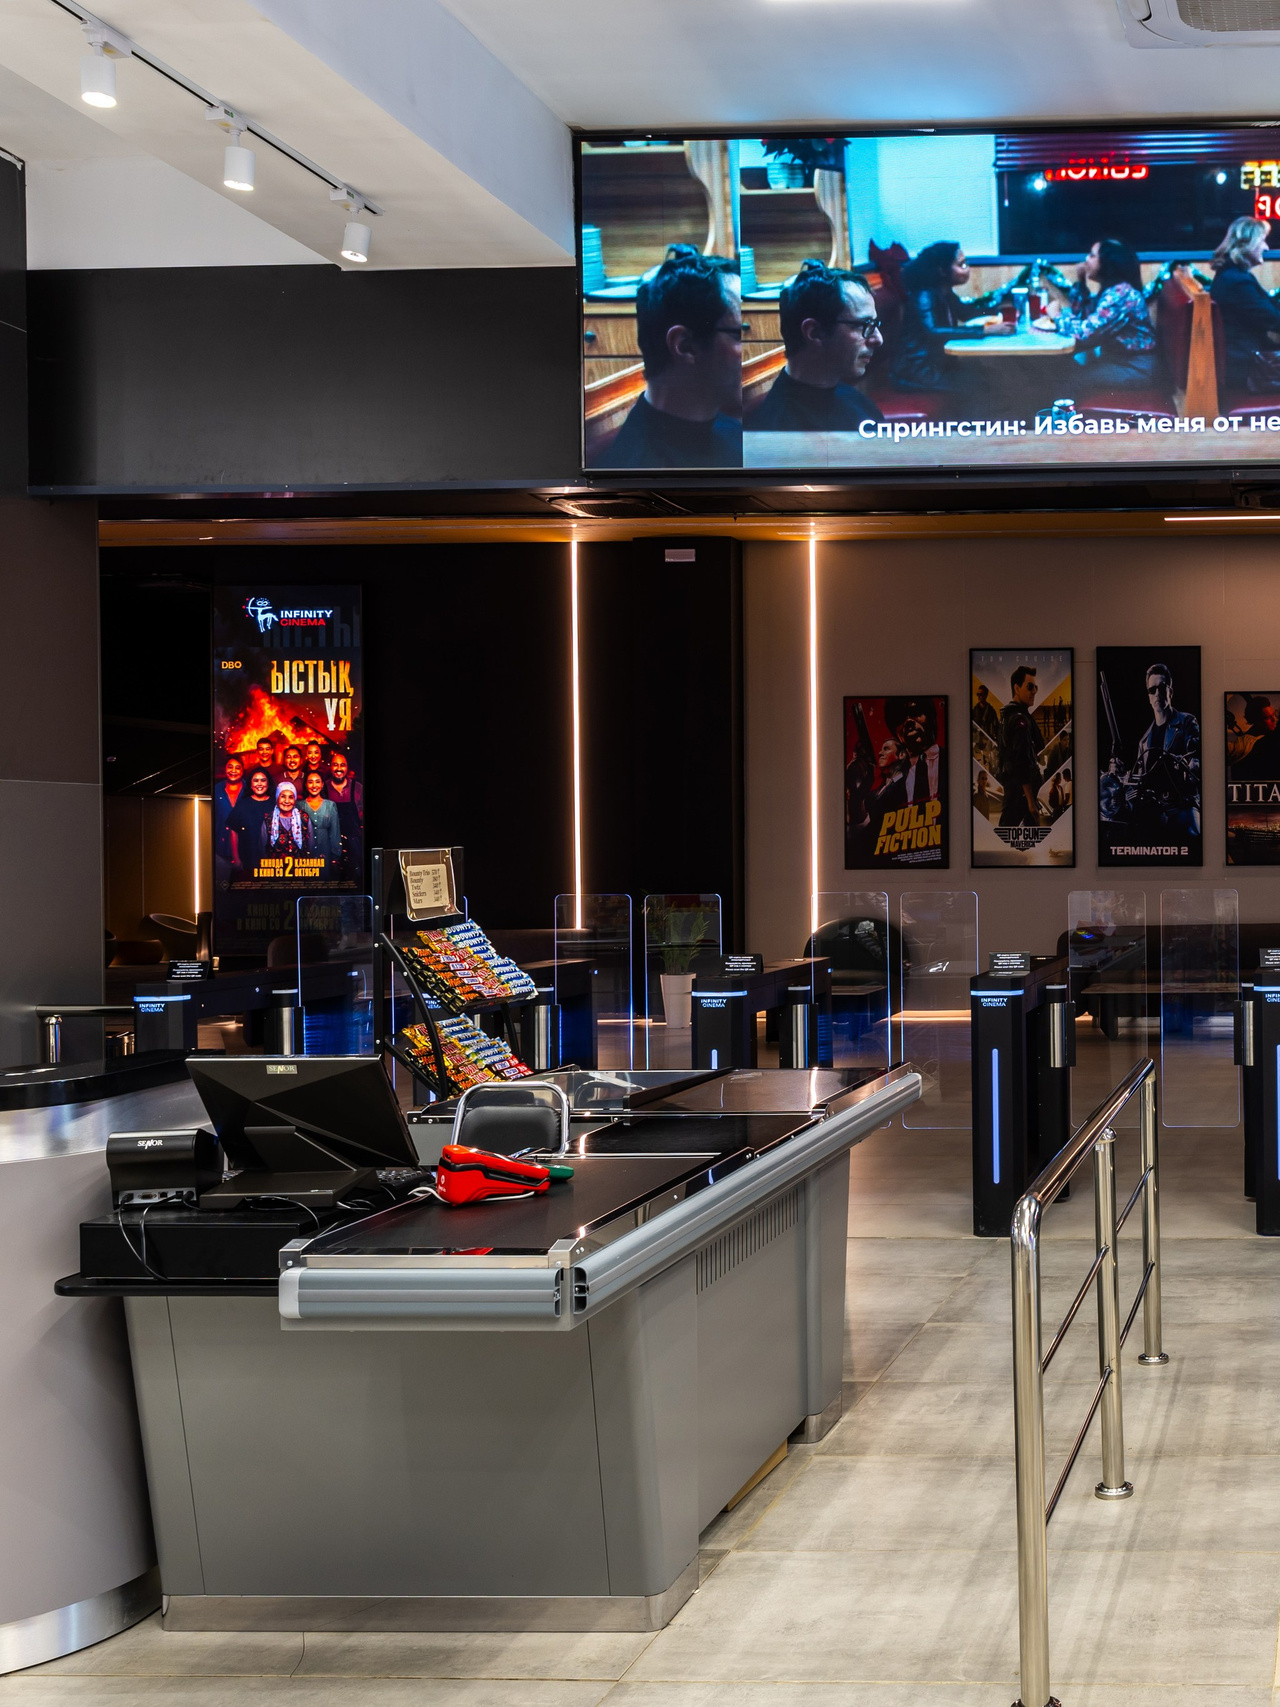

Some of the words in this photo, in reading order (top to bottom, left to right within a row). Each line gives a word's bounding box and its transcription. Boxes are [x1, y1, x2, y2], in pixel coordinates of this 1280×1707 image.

[858, 418, 1027, 443] Спрингстин:
[1034, 413, 1130, 436] Избавь
[1137, 416, 1205, 433] меня
[1213, 415, 1243, 433] от
[280, 609, 333, 618] INFINITY
[280, 618, 326, 627] CINEMA
[221, 661, 242, 670] DBO
[270, 660, 354, 697] ЫСТЫҚ
[879, 800, 942, 837] PULP
[1007, 828, 1022, 840] TOP
[1023, 828, 1040, 840] GUN
[874, 824, 942, 856] FICTION
[1110, 846, 1178, 856] TERMINATOR
[1180, 846, 1188, 856] 2
[284, 856, 294, 877] 2
[446, 922, 471, 934] BOUNTY
[455, 930, 480, 941] BOUNTY
[459, 938, 484, 948] BOUNTY
[268, 1065, 295, 1074] SENOR
[137, 1139, 163, 1149] SENOR
